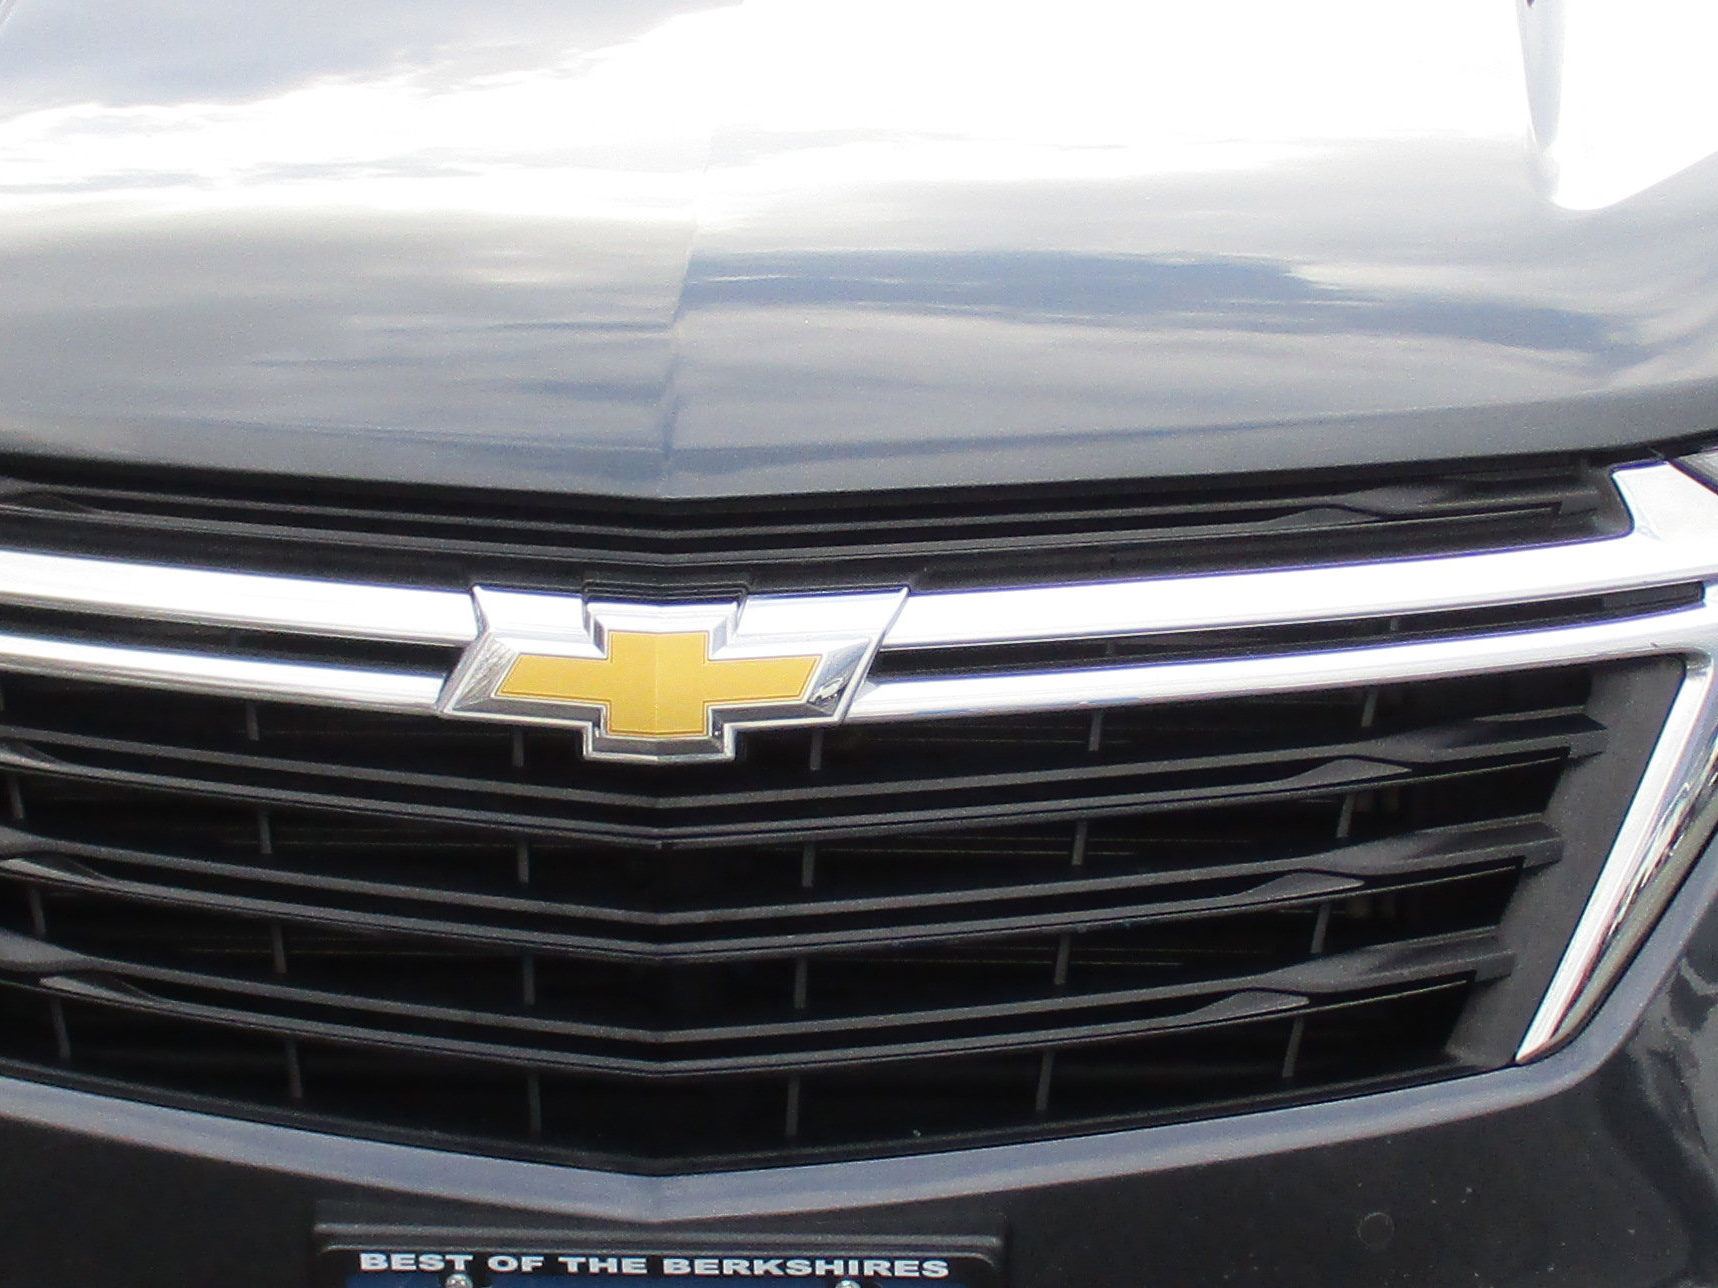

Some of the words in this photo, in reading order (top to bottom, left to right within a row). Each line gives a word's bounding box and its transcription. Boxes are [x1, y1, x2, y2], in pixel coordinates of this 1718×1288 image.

[360, 1253, 473, 1272] BEST
[487, 1255, 544, 1272] OF
[558, 1257, 647, 1274] THE
[663, 1258, 949, 1278] BERKSHIRES
